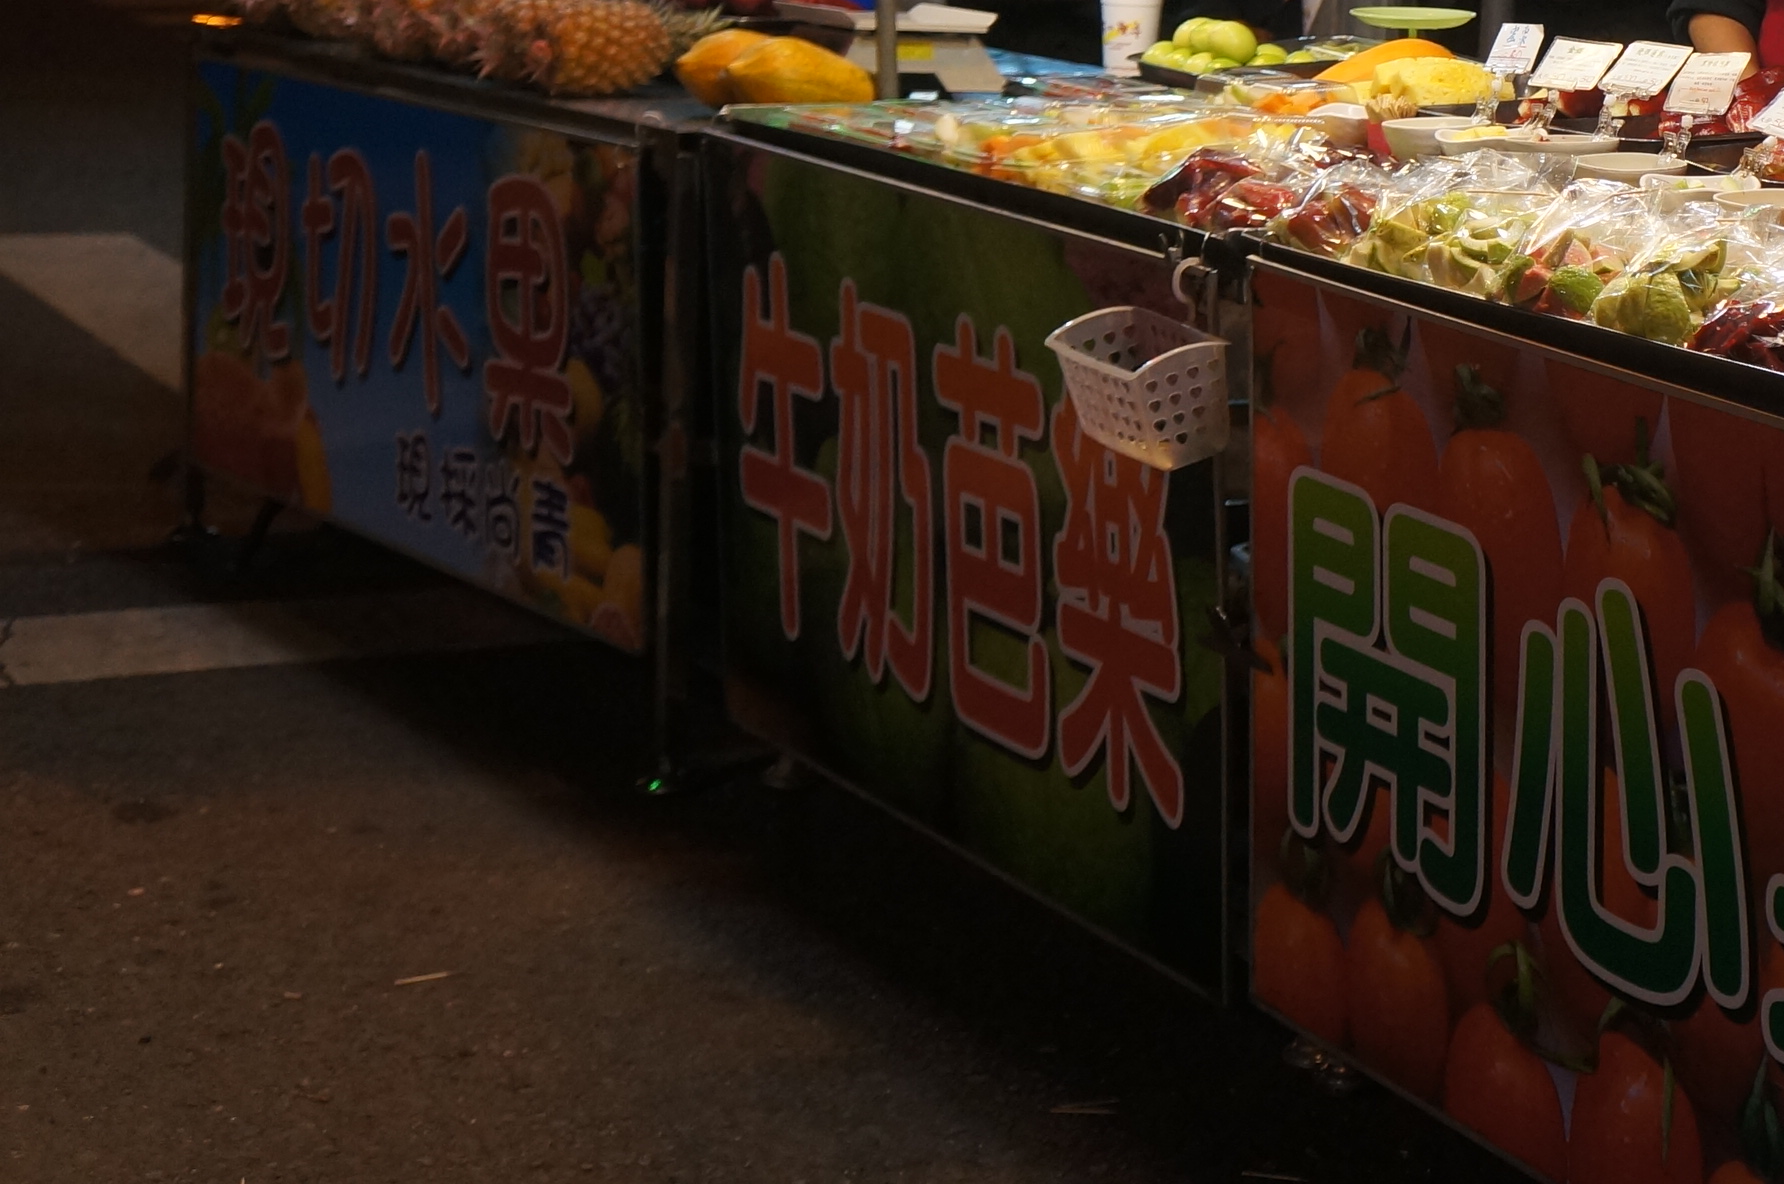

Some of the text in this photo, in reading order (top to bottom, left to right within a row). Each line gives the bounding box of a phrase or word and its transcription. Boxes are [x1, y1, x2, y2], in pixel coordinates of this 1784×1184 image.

[221, 119, 575, 467] 現切水果
[739, 250, 1184, 831] 牛奶芭樂
